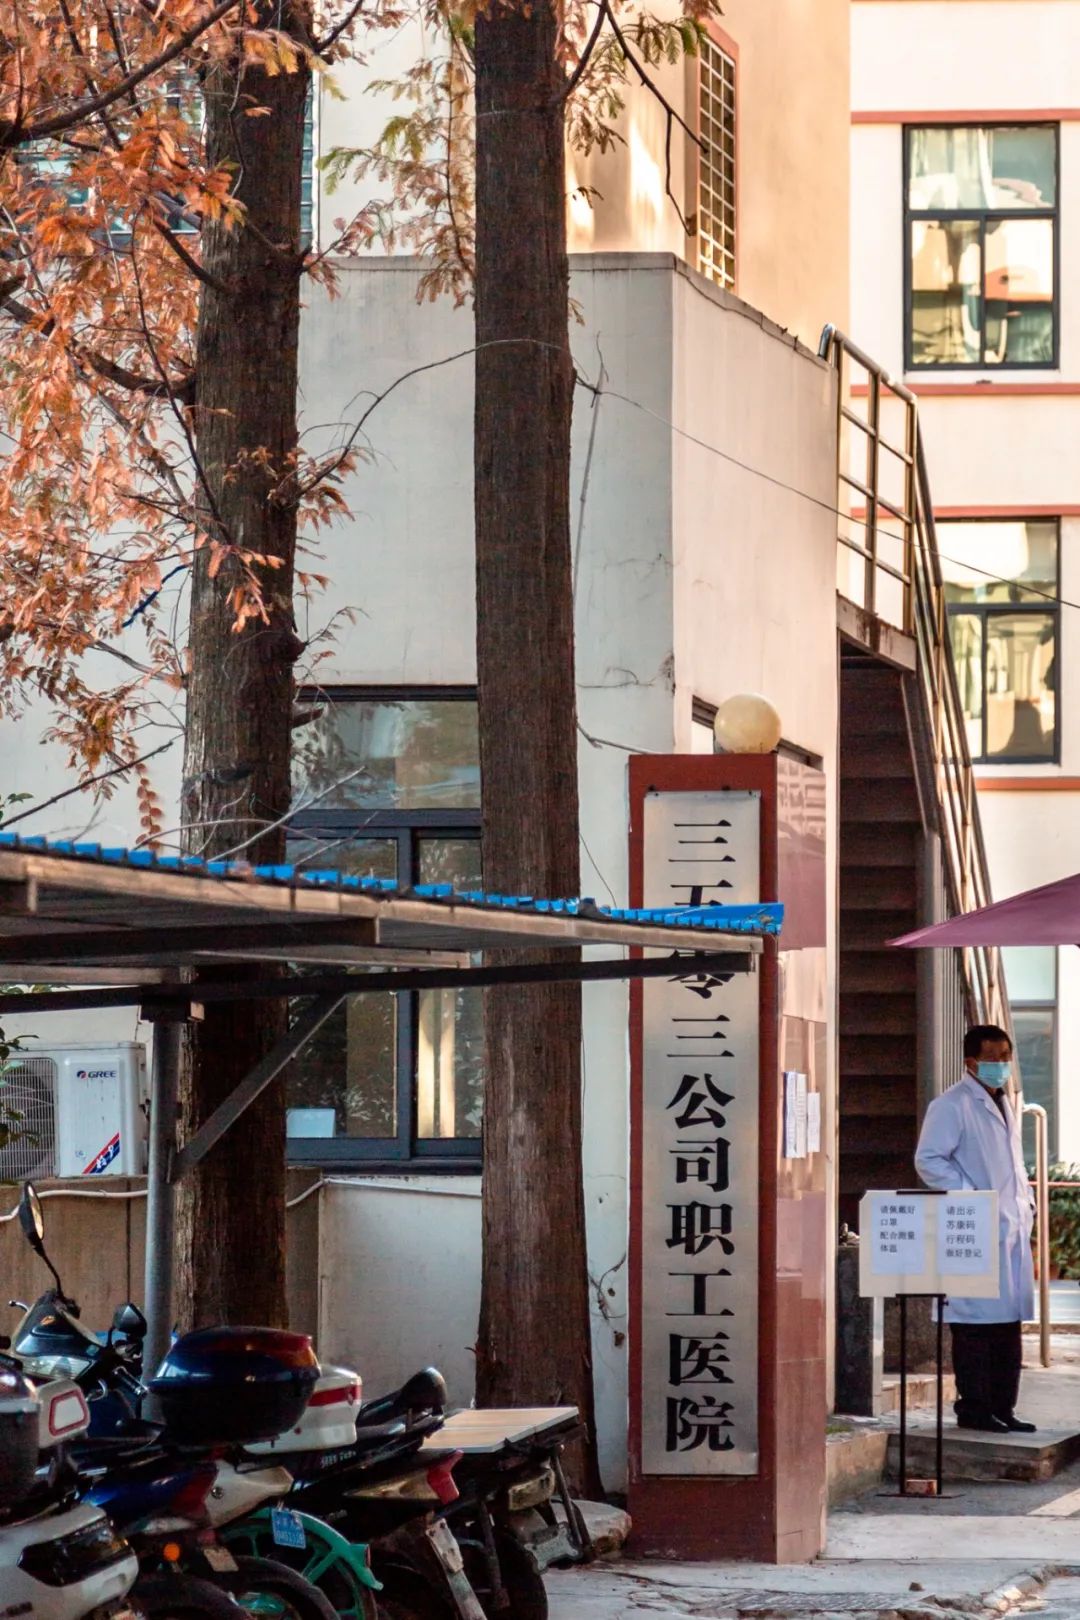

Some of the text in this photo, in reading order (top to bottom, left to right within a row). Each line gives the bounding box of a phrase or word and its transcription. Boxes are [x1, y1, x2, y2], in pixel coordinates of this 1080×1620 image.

[88, 1070, 117, 1078] GREE
[880, 1205, 916, 1215] 请佩戴好
[946, 1206, 976, 1216] 请出示
[880, 1218, 898, 1226] 口罩
[946, 1220, 976, 1230] 苏康码
[880, 1231, 916, 1240] 配合测量
[946, 1234, 976, 1245] 行程码
[880, 1244, 898, 1253] 体温
